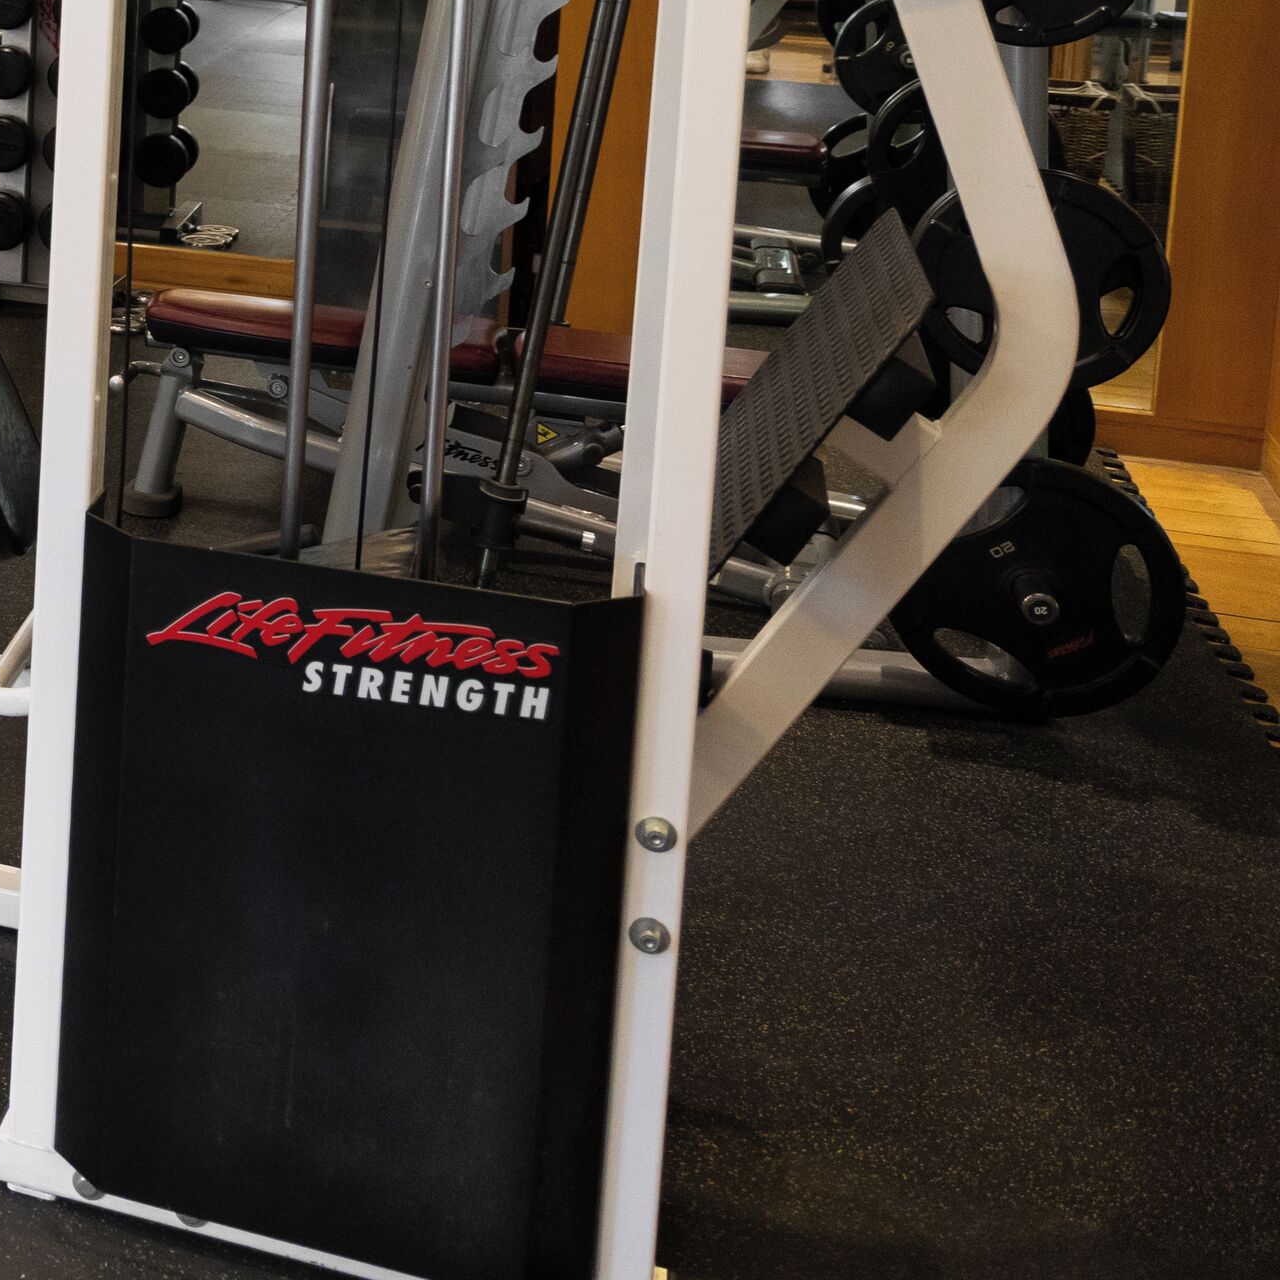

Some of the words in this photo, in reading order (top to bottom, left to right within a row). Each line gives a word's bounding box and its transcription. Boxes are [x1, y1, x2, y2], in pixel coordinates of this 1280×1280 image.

[988, 540, 1016, 558] 20
[1033, 606, 1048, 615] 20
[145, 589, 561, 679] LifeFitness
[302, 661, 551, 721] STRENGTH
